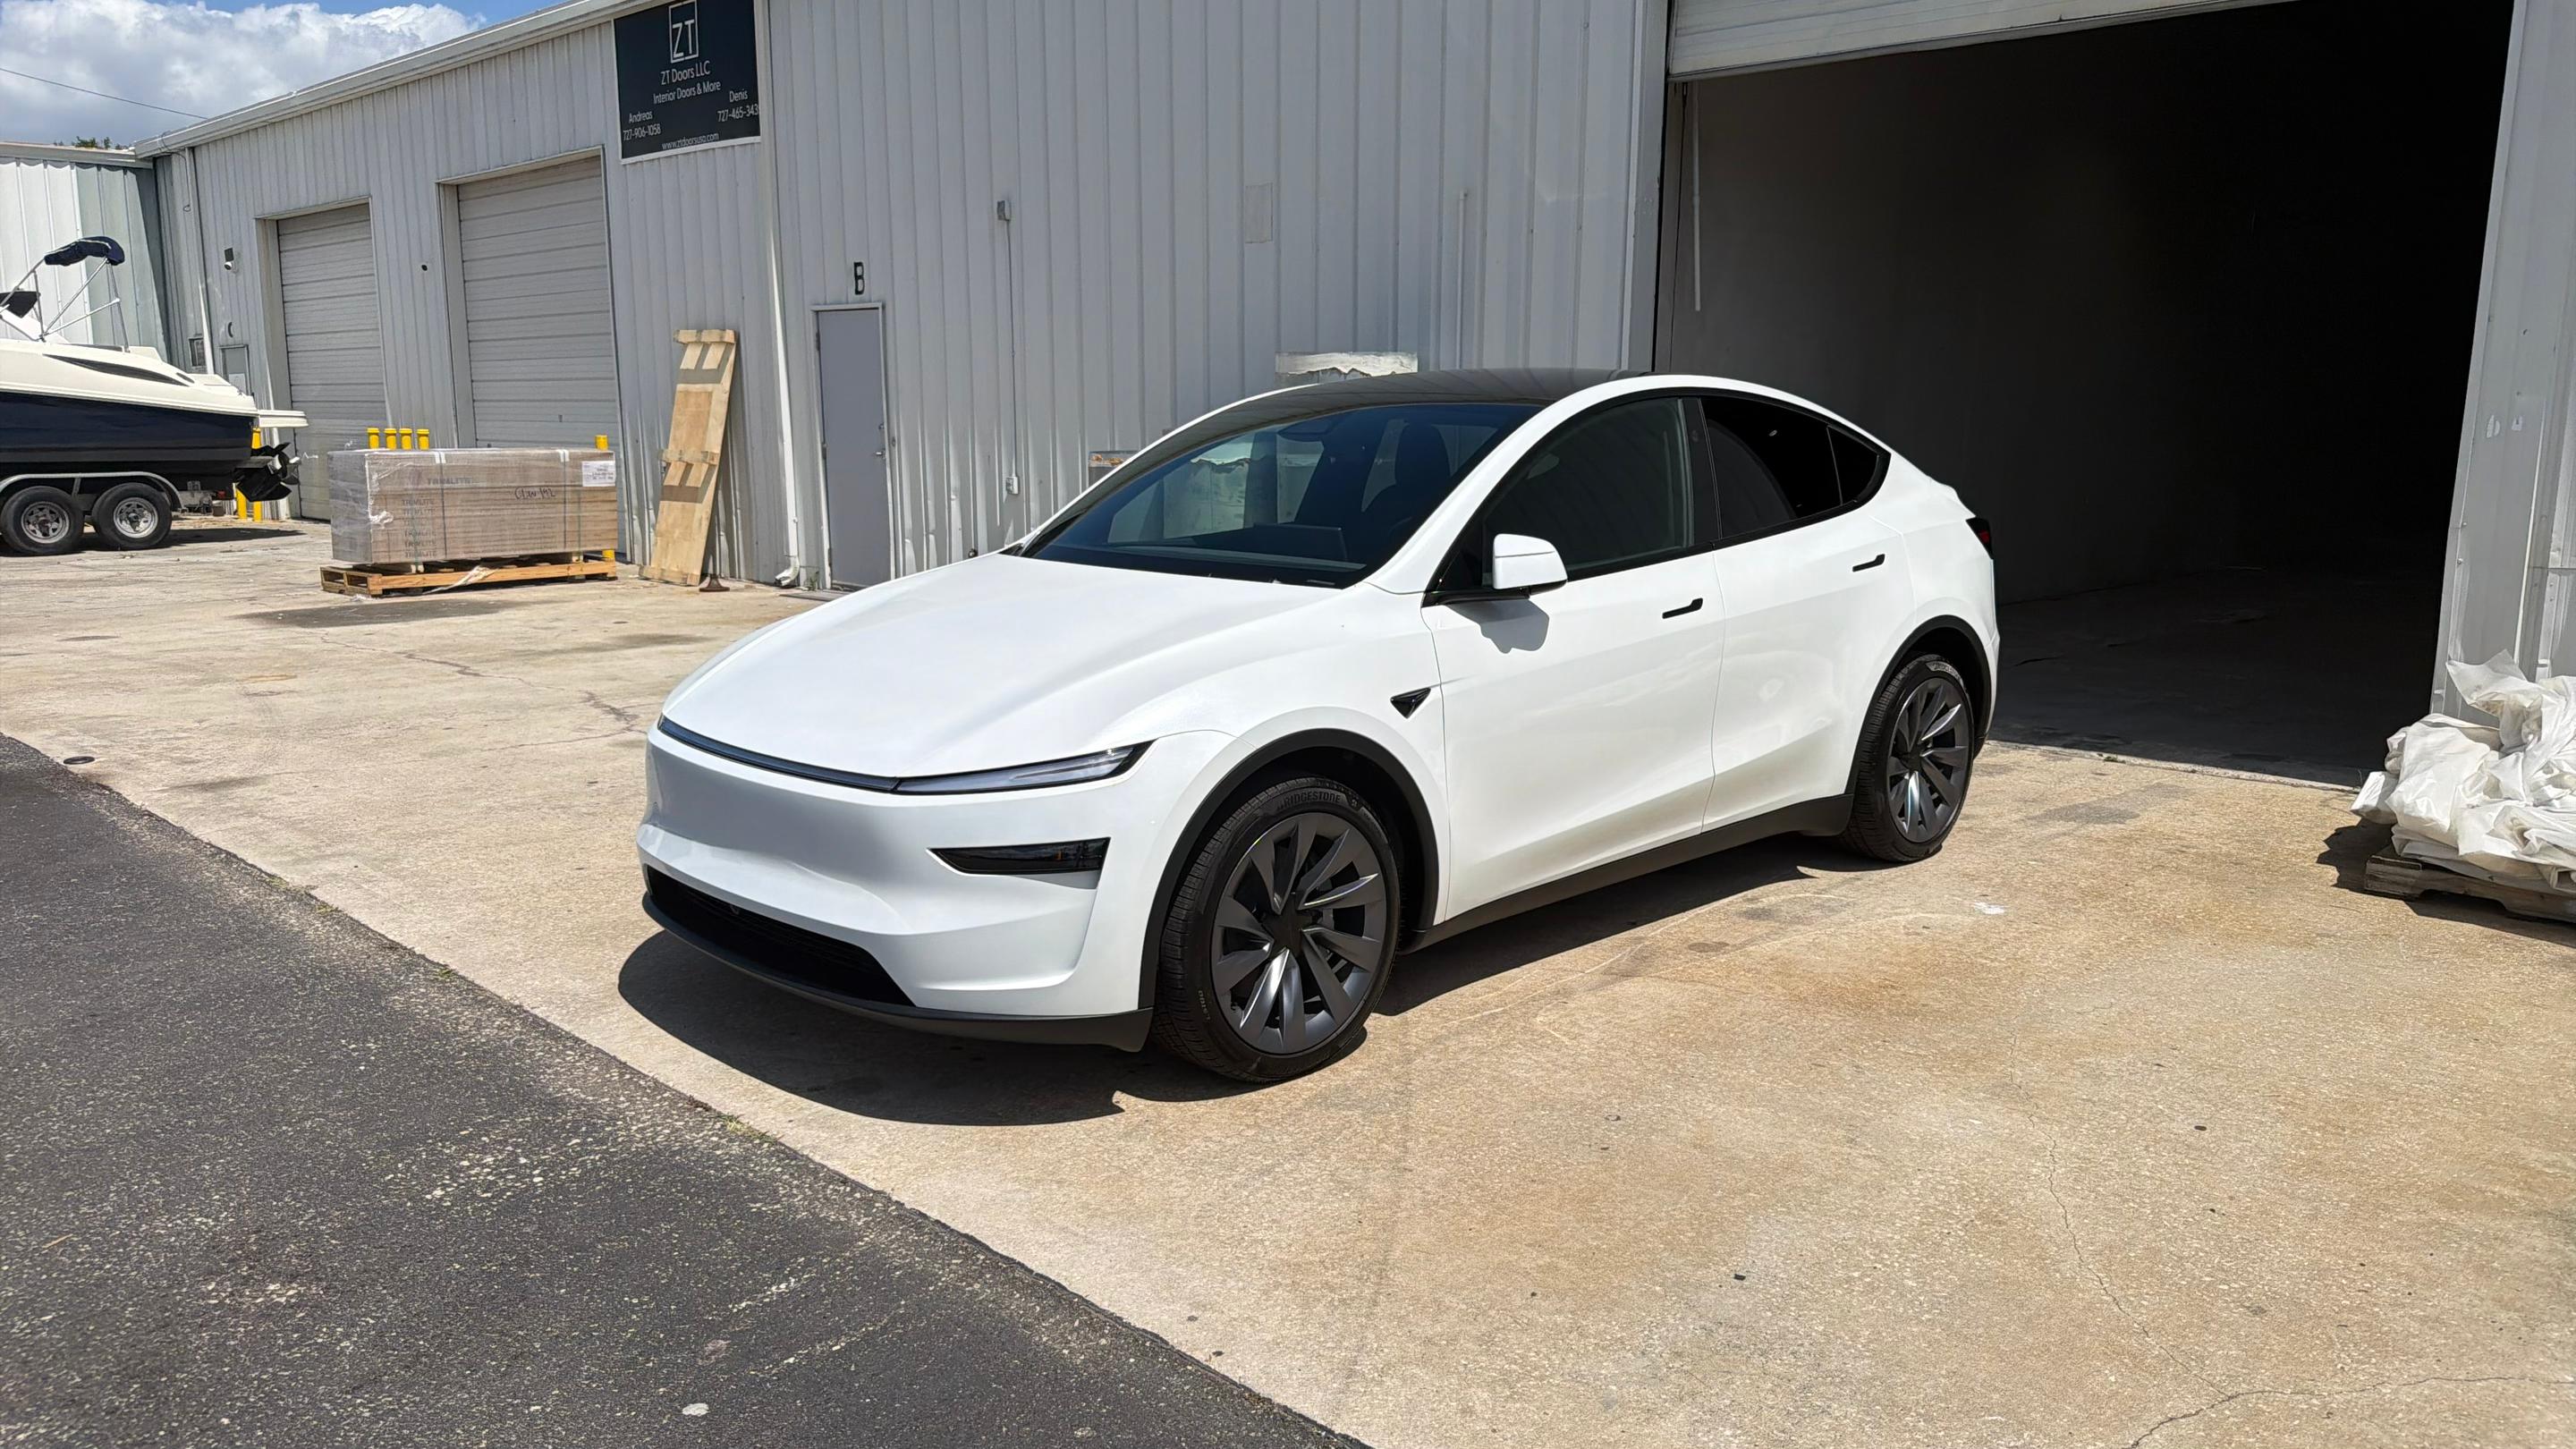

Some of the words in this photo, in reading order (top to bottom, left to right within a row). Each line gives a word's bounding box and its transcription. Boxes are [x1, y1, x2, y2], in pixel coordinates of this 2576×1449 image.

[672, 20, 695, 58] ZT
[660, 70, 670, 85] ZT
[672, 67, 695, 83] Doors
[695, 60, 711, 77] LLC
[653, 89, 676, 105] Interior
[676, 87, 696, 99] Doors
[697, 82, 703, 95] &
[703, 80, 721, 93] More
[729, 89, 748, 103] Denis
[629, 111, 653, 123] Andreas
[717, 104, 759, 122] 727-465-343
[623, 123, 661, 141] 727-906-1058
[853, 262, 865, 294] B
